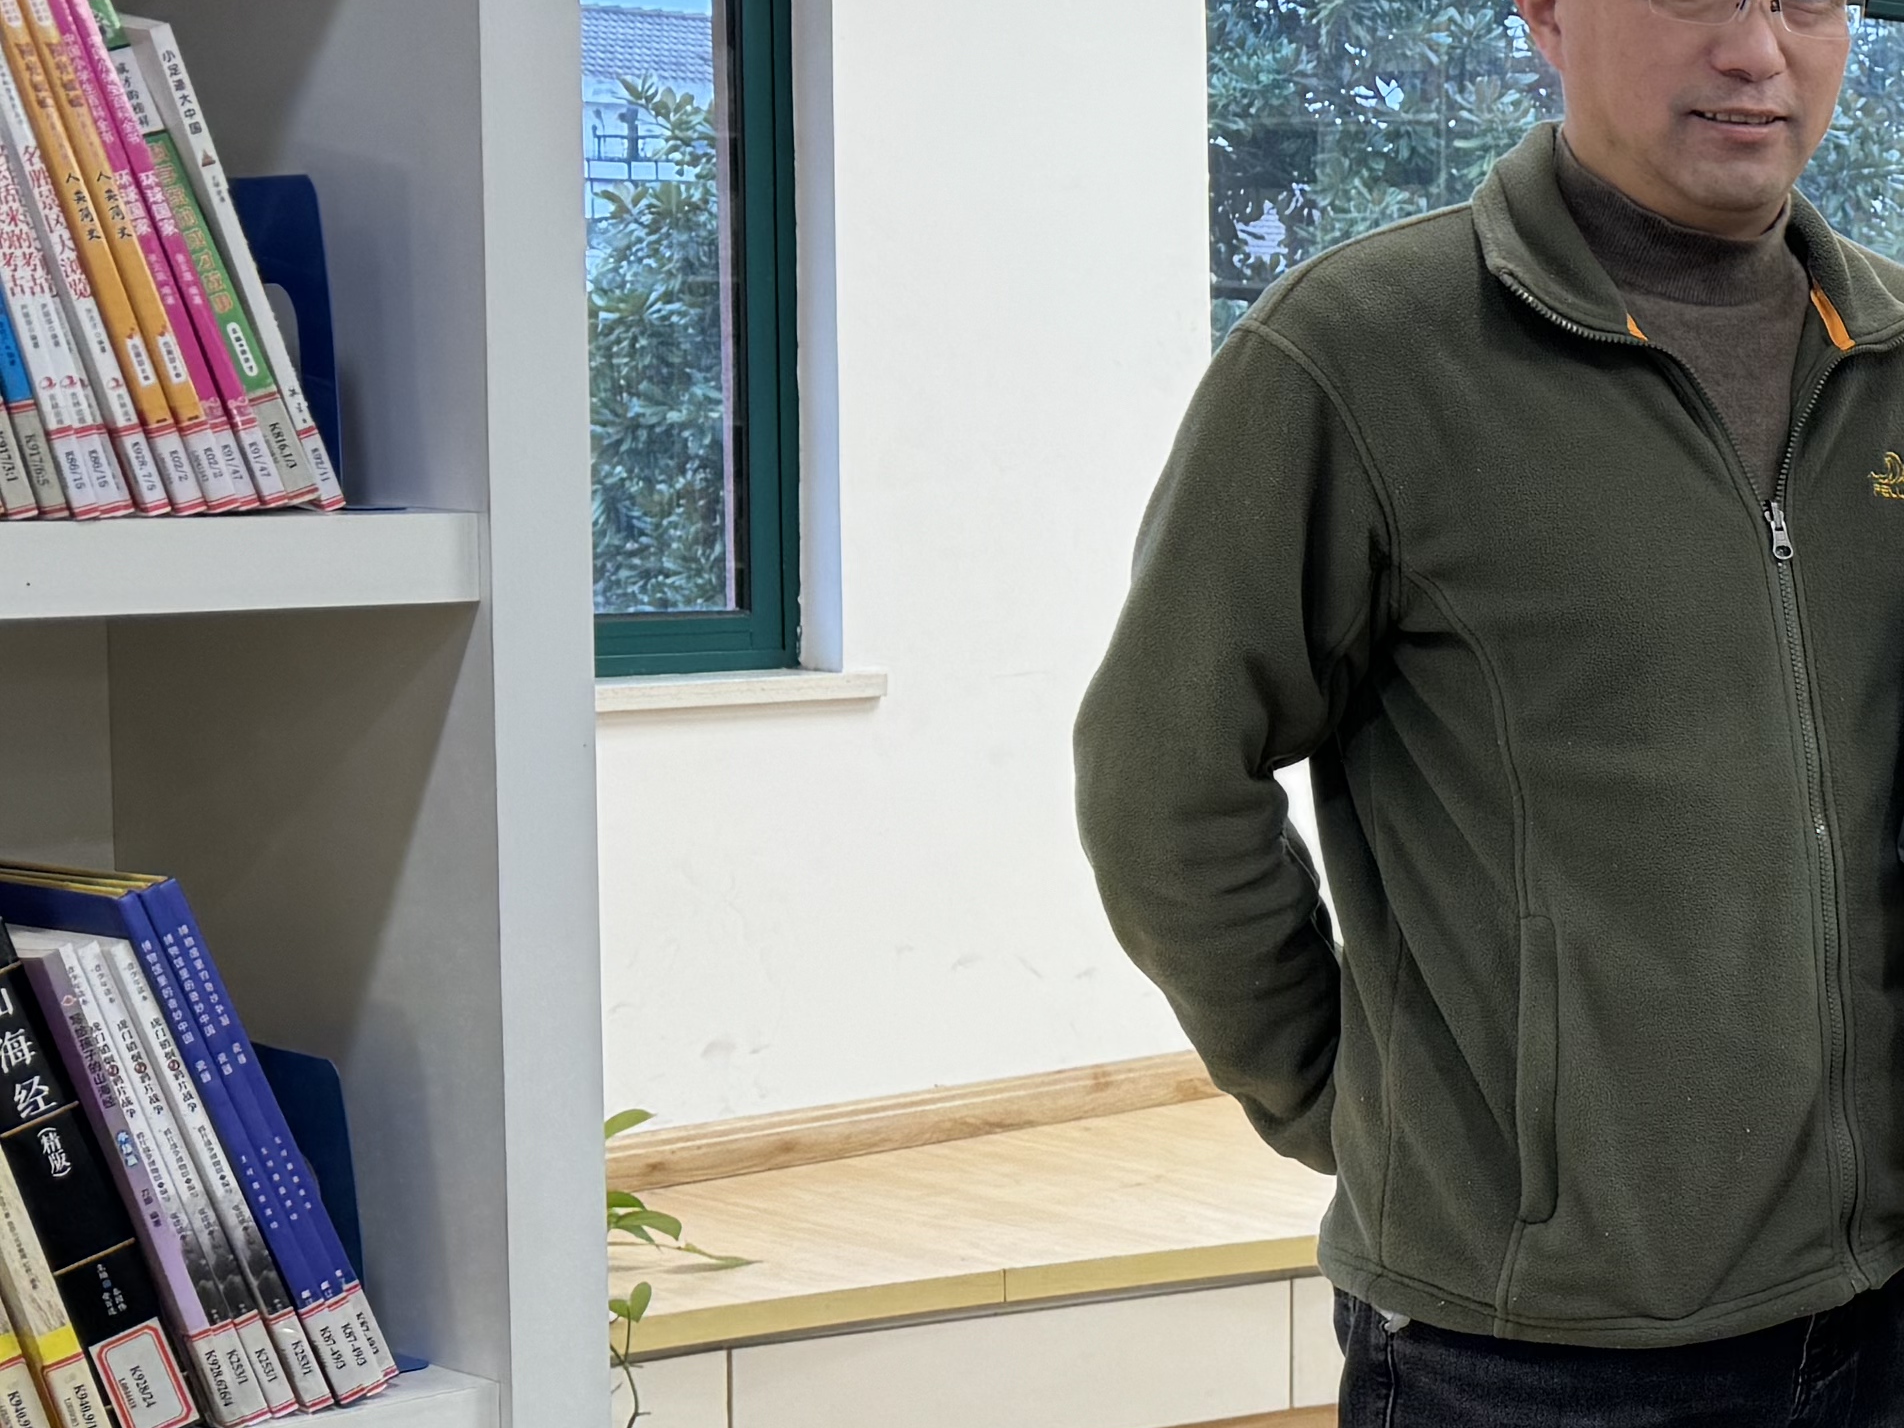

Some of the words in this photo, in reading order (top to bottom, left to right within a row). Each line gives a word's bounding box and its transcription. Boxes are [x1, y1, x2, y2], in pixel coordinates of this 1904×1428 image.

[137, 171, 178, 237] 环球国家
[226, 1349, 249, 1385] K253/1
[254, 1348, 278, 1383] K253/1
[291, 1340, 314, 1376] K253/1
[129, 1365, 157, 1409] K928/24
